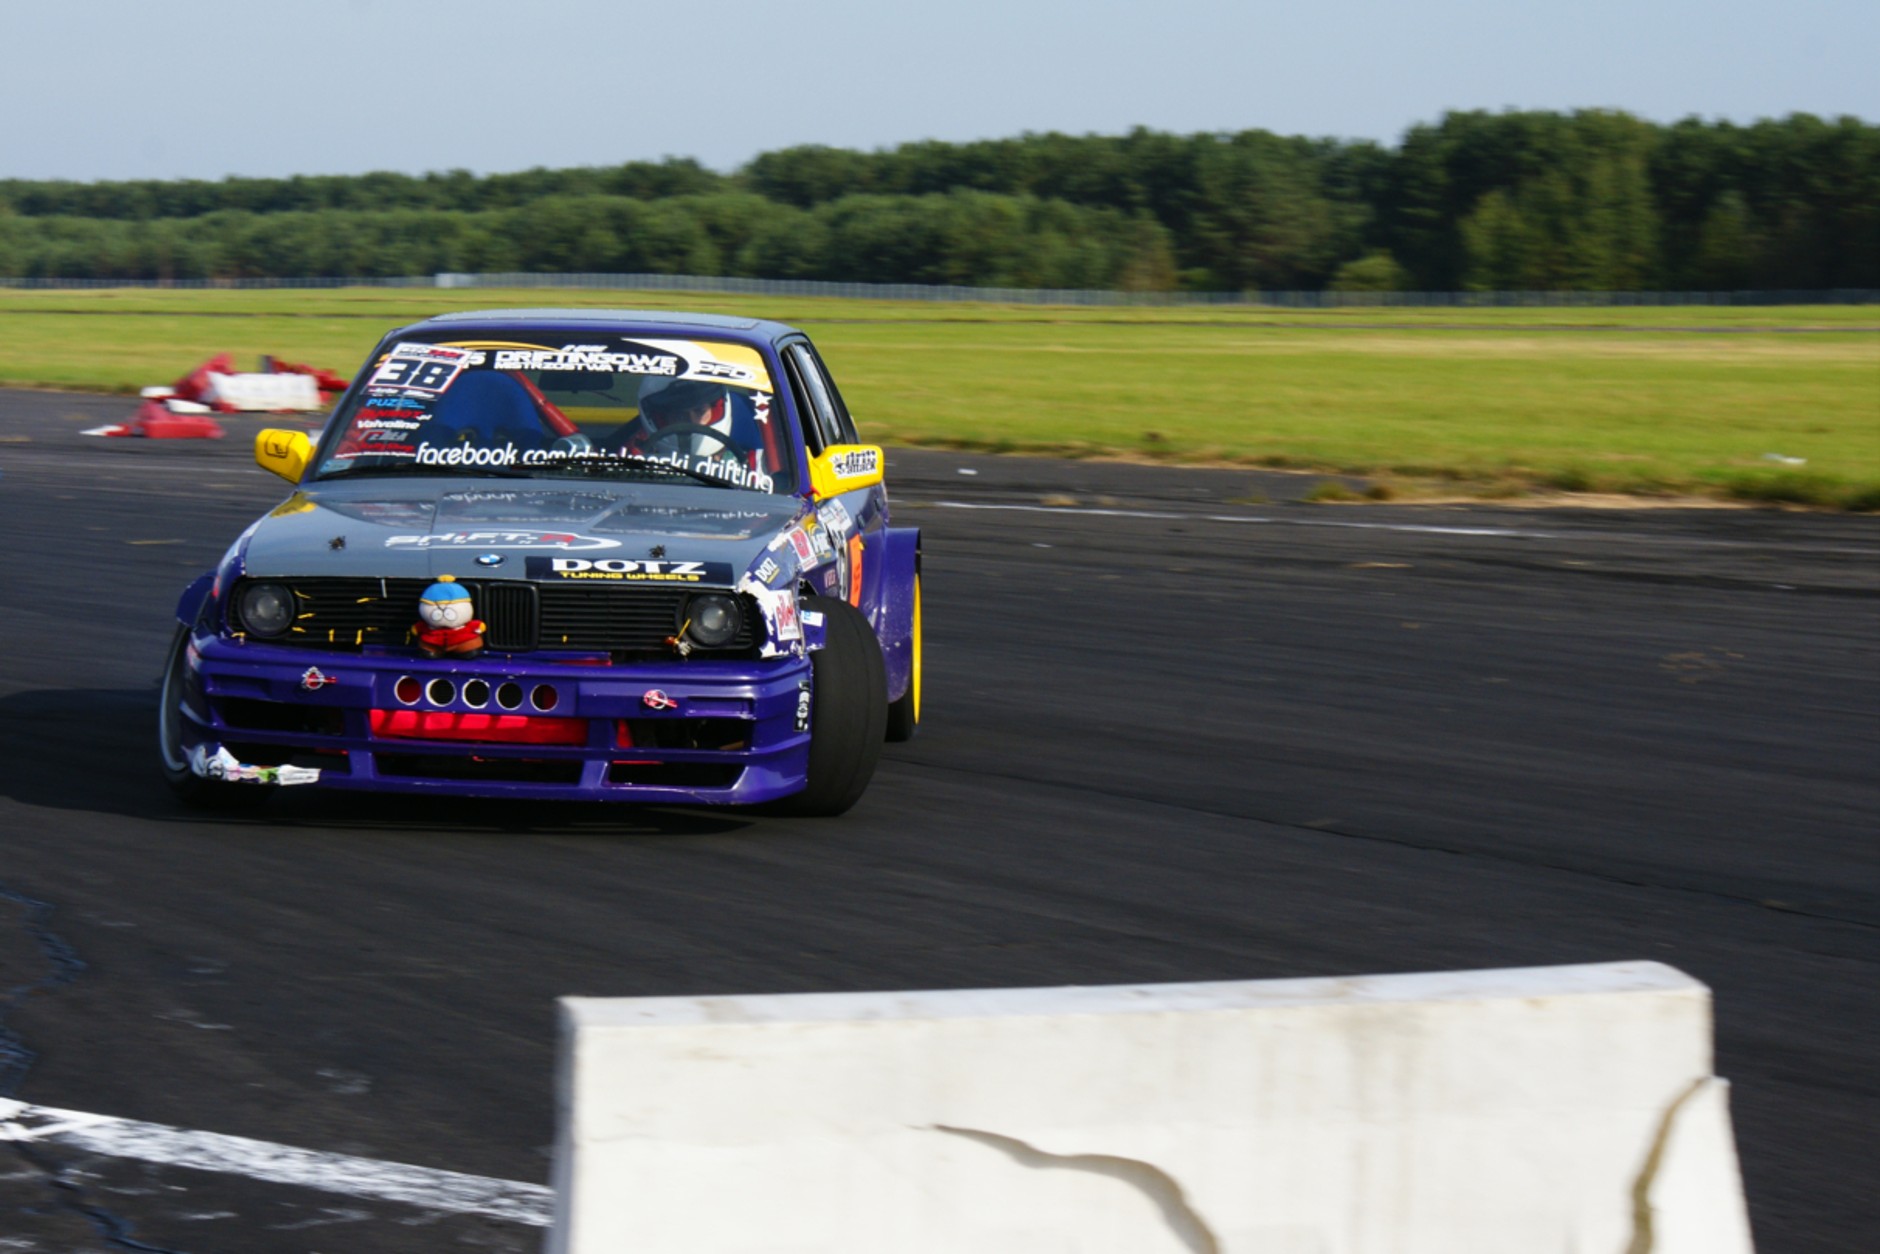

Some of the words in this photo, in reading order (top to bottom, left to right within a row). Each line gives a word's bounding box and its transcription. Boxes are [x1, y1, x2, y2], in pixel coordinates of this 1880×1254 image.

[495, 350, 678, 367] DRIFTINGOWE
[372, 358, 457, 391] 38
[493, 361, 614, 372] MISTRZOSTWA
[618, 364, 677, 376] POLSKI
[358, 419, 420, 429] Valvoline
[552, 558, 706, 575] DOTZ
[754, 557, 776, 582] DOTZ
[560, 571, 623, 579] TUNING
[627, 573, 699, 582] WHEELS
